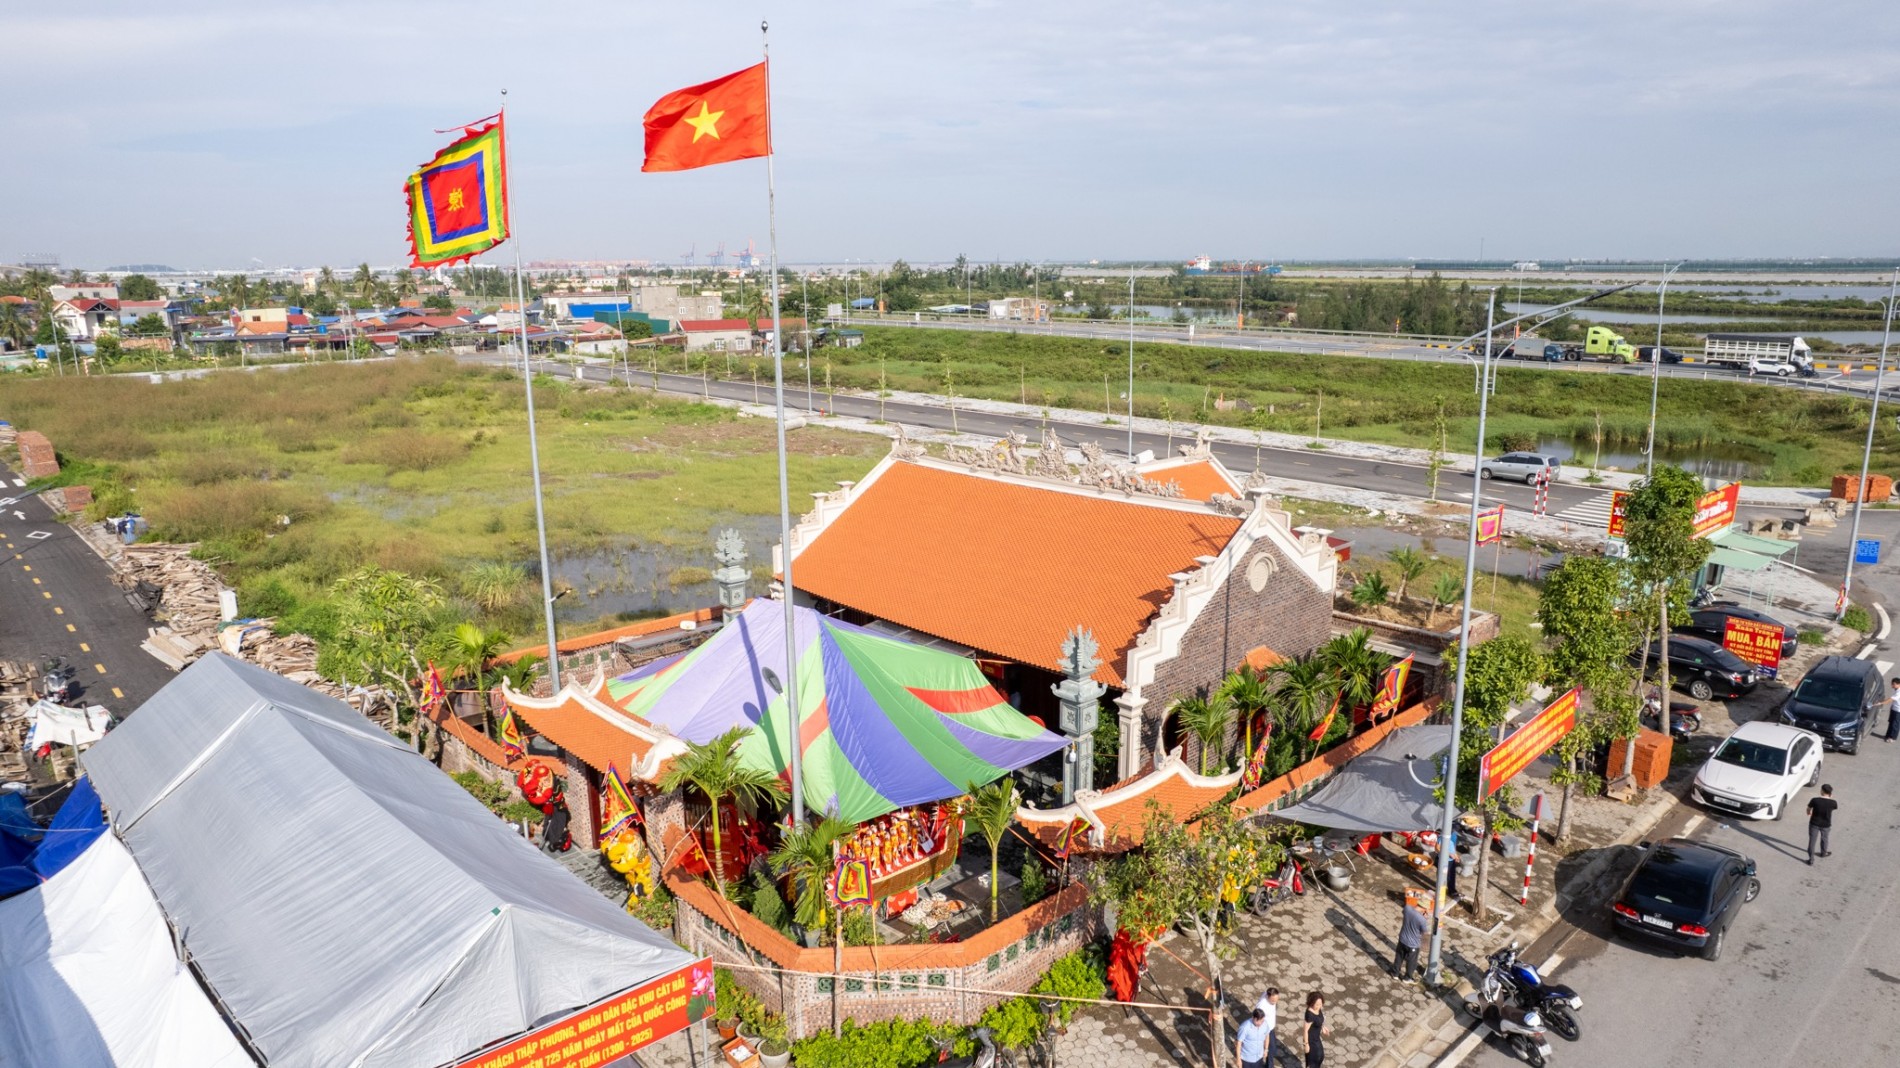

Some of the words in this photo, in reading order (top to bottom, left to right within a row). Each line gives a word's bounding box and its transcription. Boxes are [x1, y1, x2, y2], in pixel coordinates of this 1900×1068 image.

[1726, 630, 1754, 646] MUA,
[1756, 635, 1780, 651] BÁN
[516, 1041, 538, 1060] THẬP
[539, 1026, 577, 1050] PHƯƠNG,
[578, 1011, 602, 1033] NHÂN
[603, 1005, 620, 1023] DÂN
[621, 995, 638, 1014] ĐẶC
[638, 989, 655, 1007] KHU
[656, 982, 671, 999] CÁT
[672, 974, 686, 992] HẢI
[545, 1050, 561, 1067] 725
[562, 1042, 582, 1059] NĂM
[584, 1029, 606, 1049] NGÀY
[607, 1020, 624, 1039] MẤT
[625, 1012, 642, 1031] CỦA
[643, 1001, 665, 1022] QUỐC
[665, 994, 687, 1013] CÔNG
[579, 1050, 600, 1068] TUẤN
[601, 1040, 625, 1060] (1300
[631, 1027, 653, 1046] 2025)
